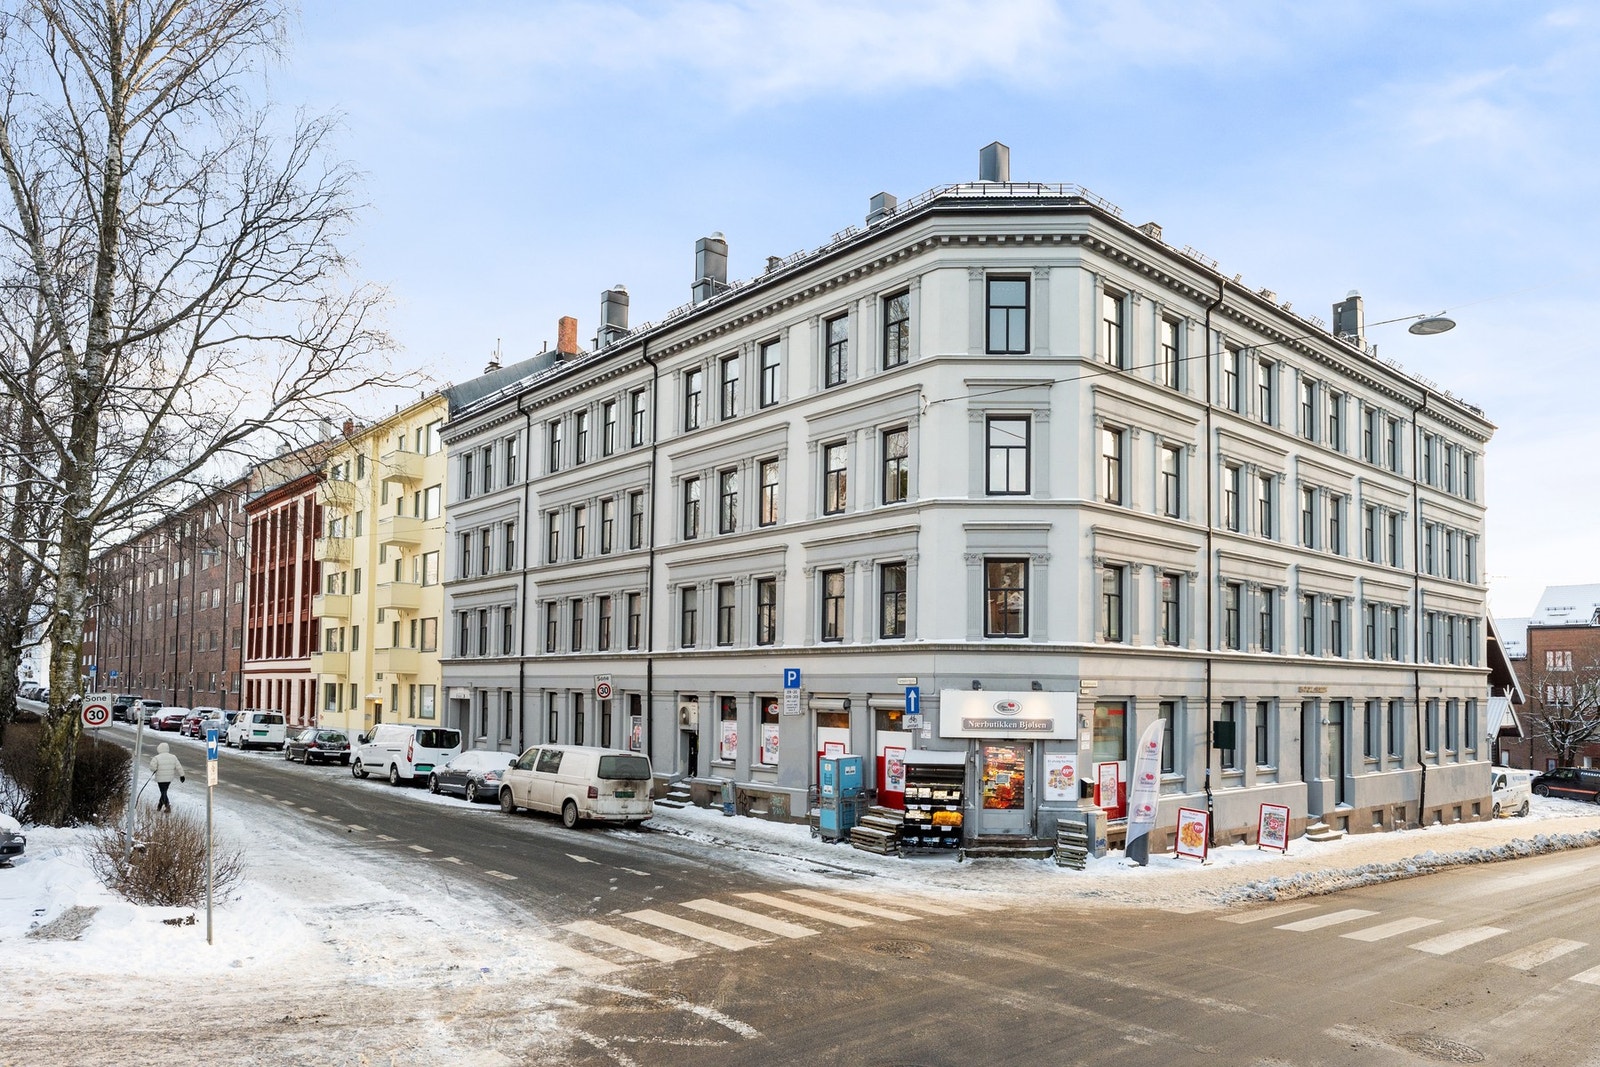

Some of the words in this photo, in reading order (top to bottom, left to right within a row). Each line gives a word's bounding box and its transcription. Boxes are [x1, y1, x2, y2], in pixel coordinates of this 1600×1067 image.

[788, 671, 797, 686] P
[89, 710, 104, 720] 30
[968, 720, 1017, 728] Nærbutikken
[1019, 720, 1047, 729] Bjølsen
